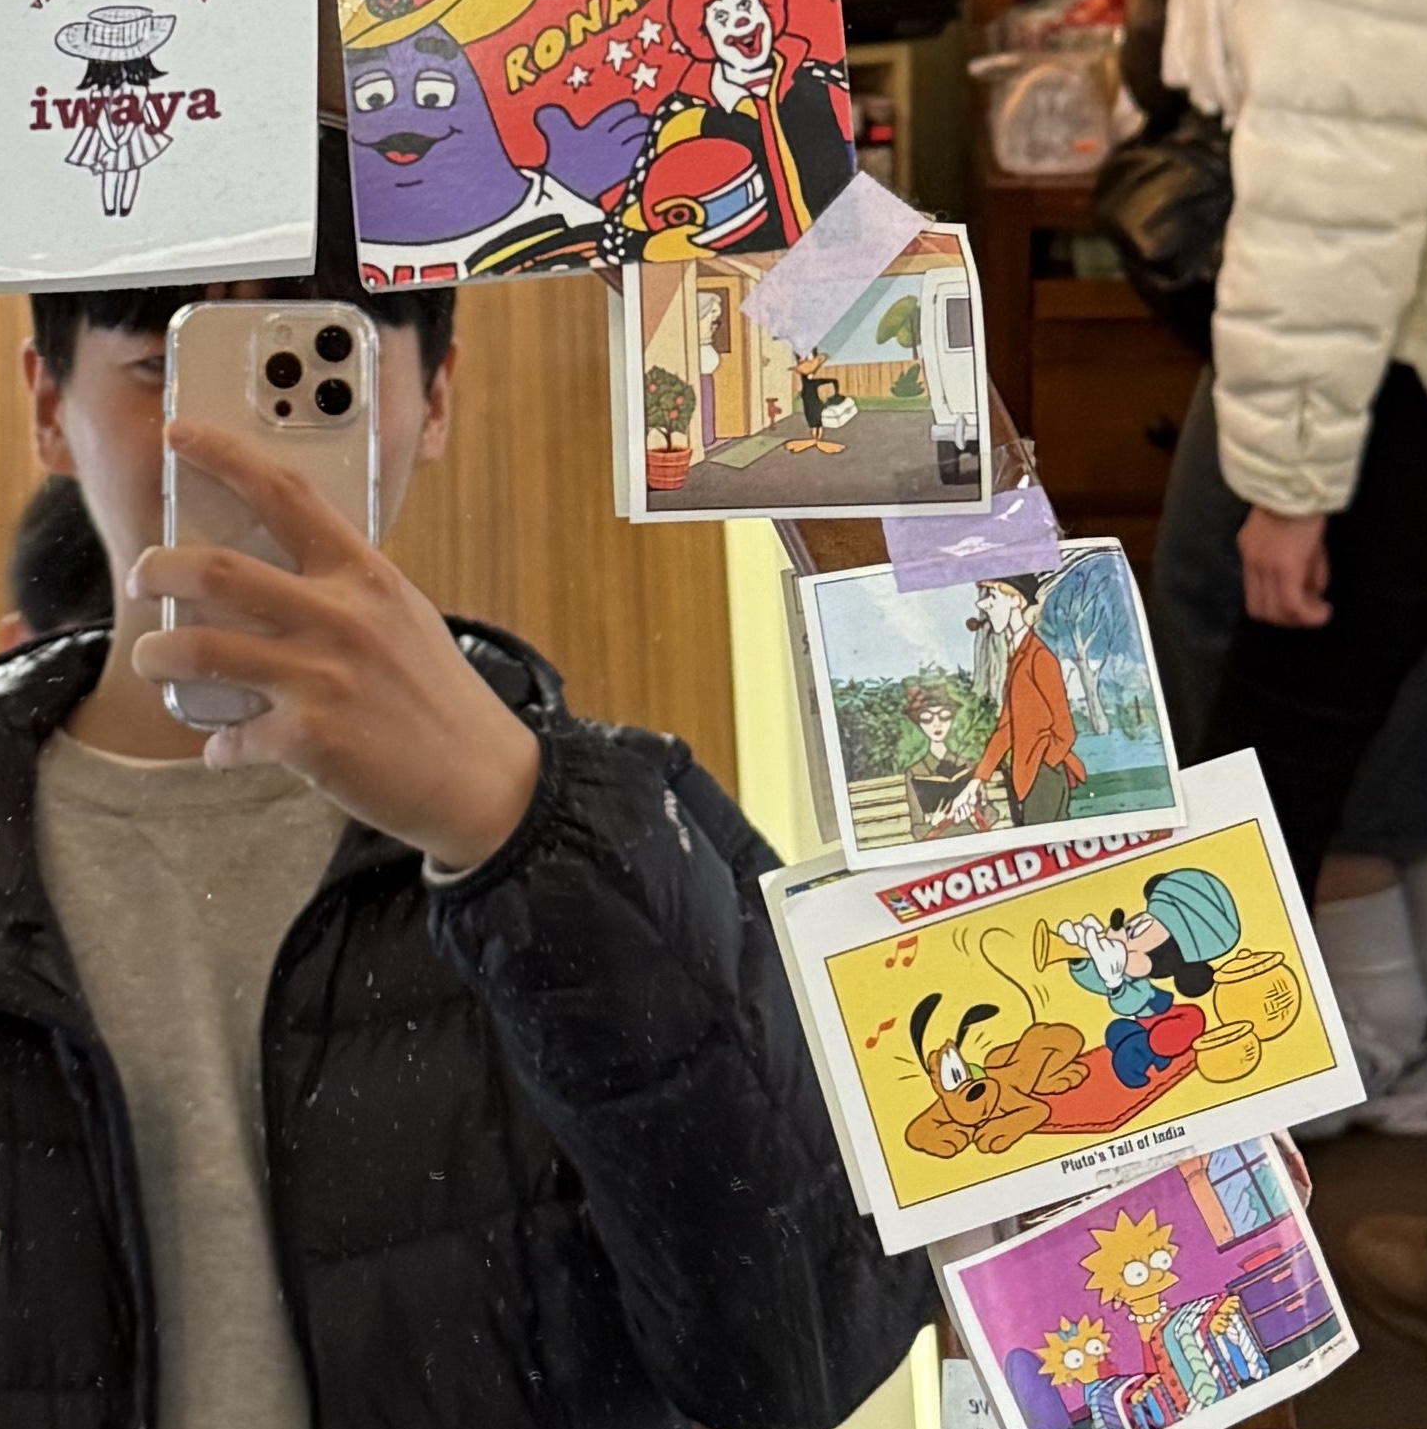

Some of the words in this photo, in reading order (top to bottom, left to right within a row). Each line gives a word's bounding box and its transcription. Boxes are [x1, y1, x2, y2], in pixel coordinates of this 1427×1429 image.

[29, 86, 222, 135] iwaya
[910, 850, 1042, 911] WORLD
[1060, 1150, 1107, 1174] Pluto's
[1137, 1134, 1150, 1150] of
[1152, 1124, 1186, 1145] India
